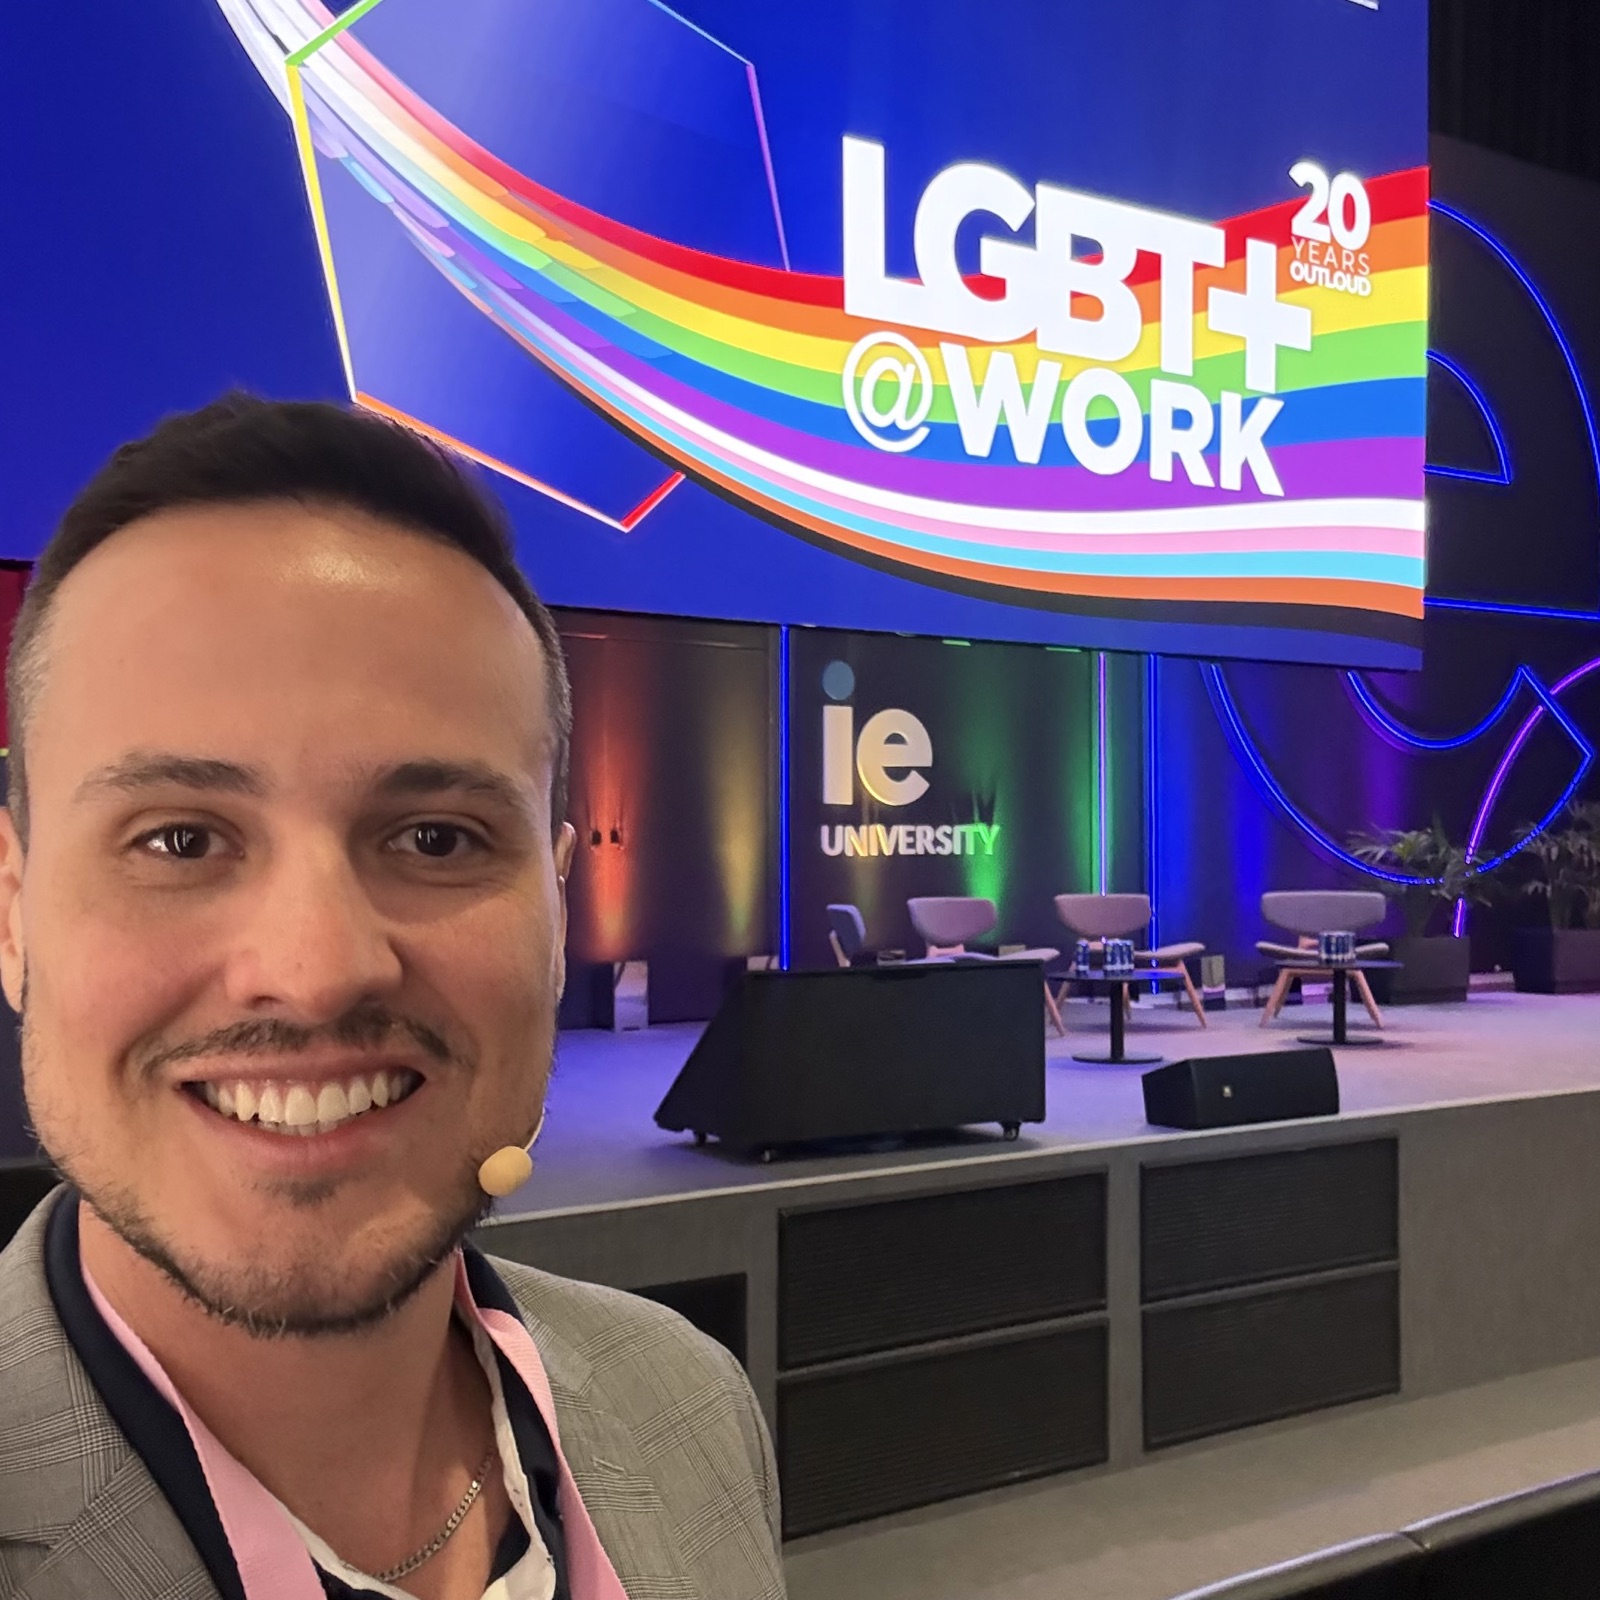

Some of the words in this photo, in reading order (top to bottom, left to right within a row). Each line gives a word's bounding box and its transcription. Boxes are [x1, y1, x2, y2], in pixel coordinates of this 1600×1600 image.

[1288, 161, 1371, 251] 20
[842, 135, 1312, 394] LGBT+
[1289, 260, 1372, 297] OUTLOUD
[1291, 235, 1370, 276] YEARS
[822, 660, 933, 806] ie
[820, 823, 1000, 857] UNIVERSITY
